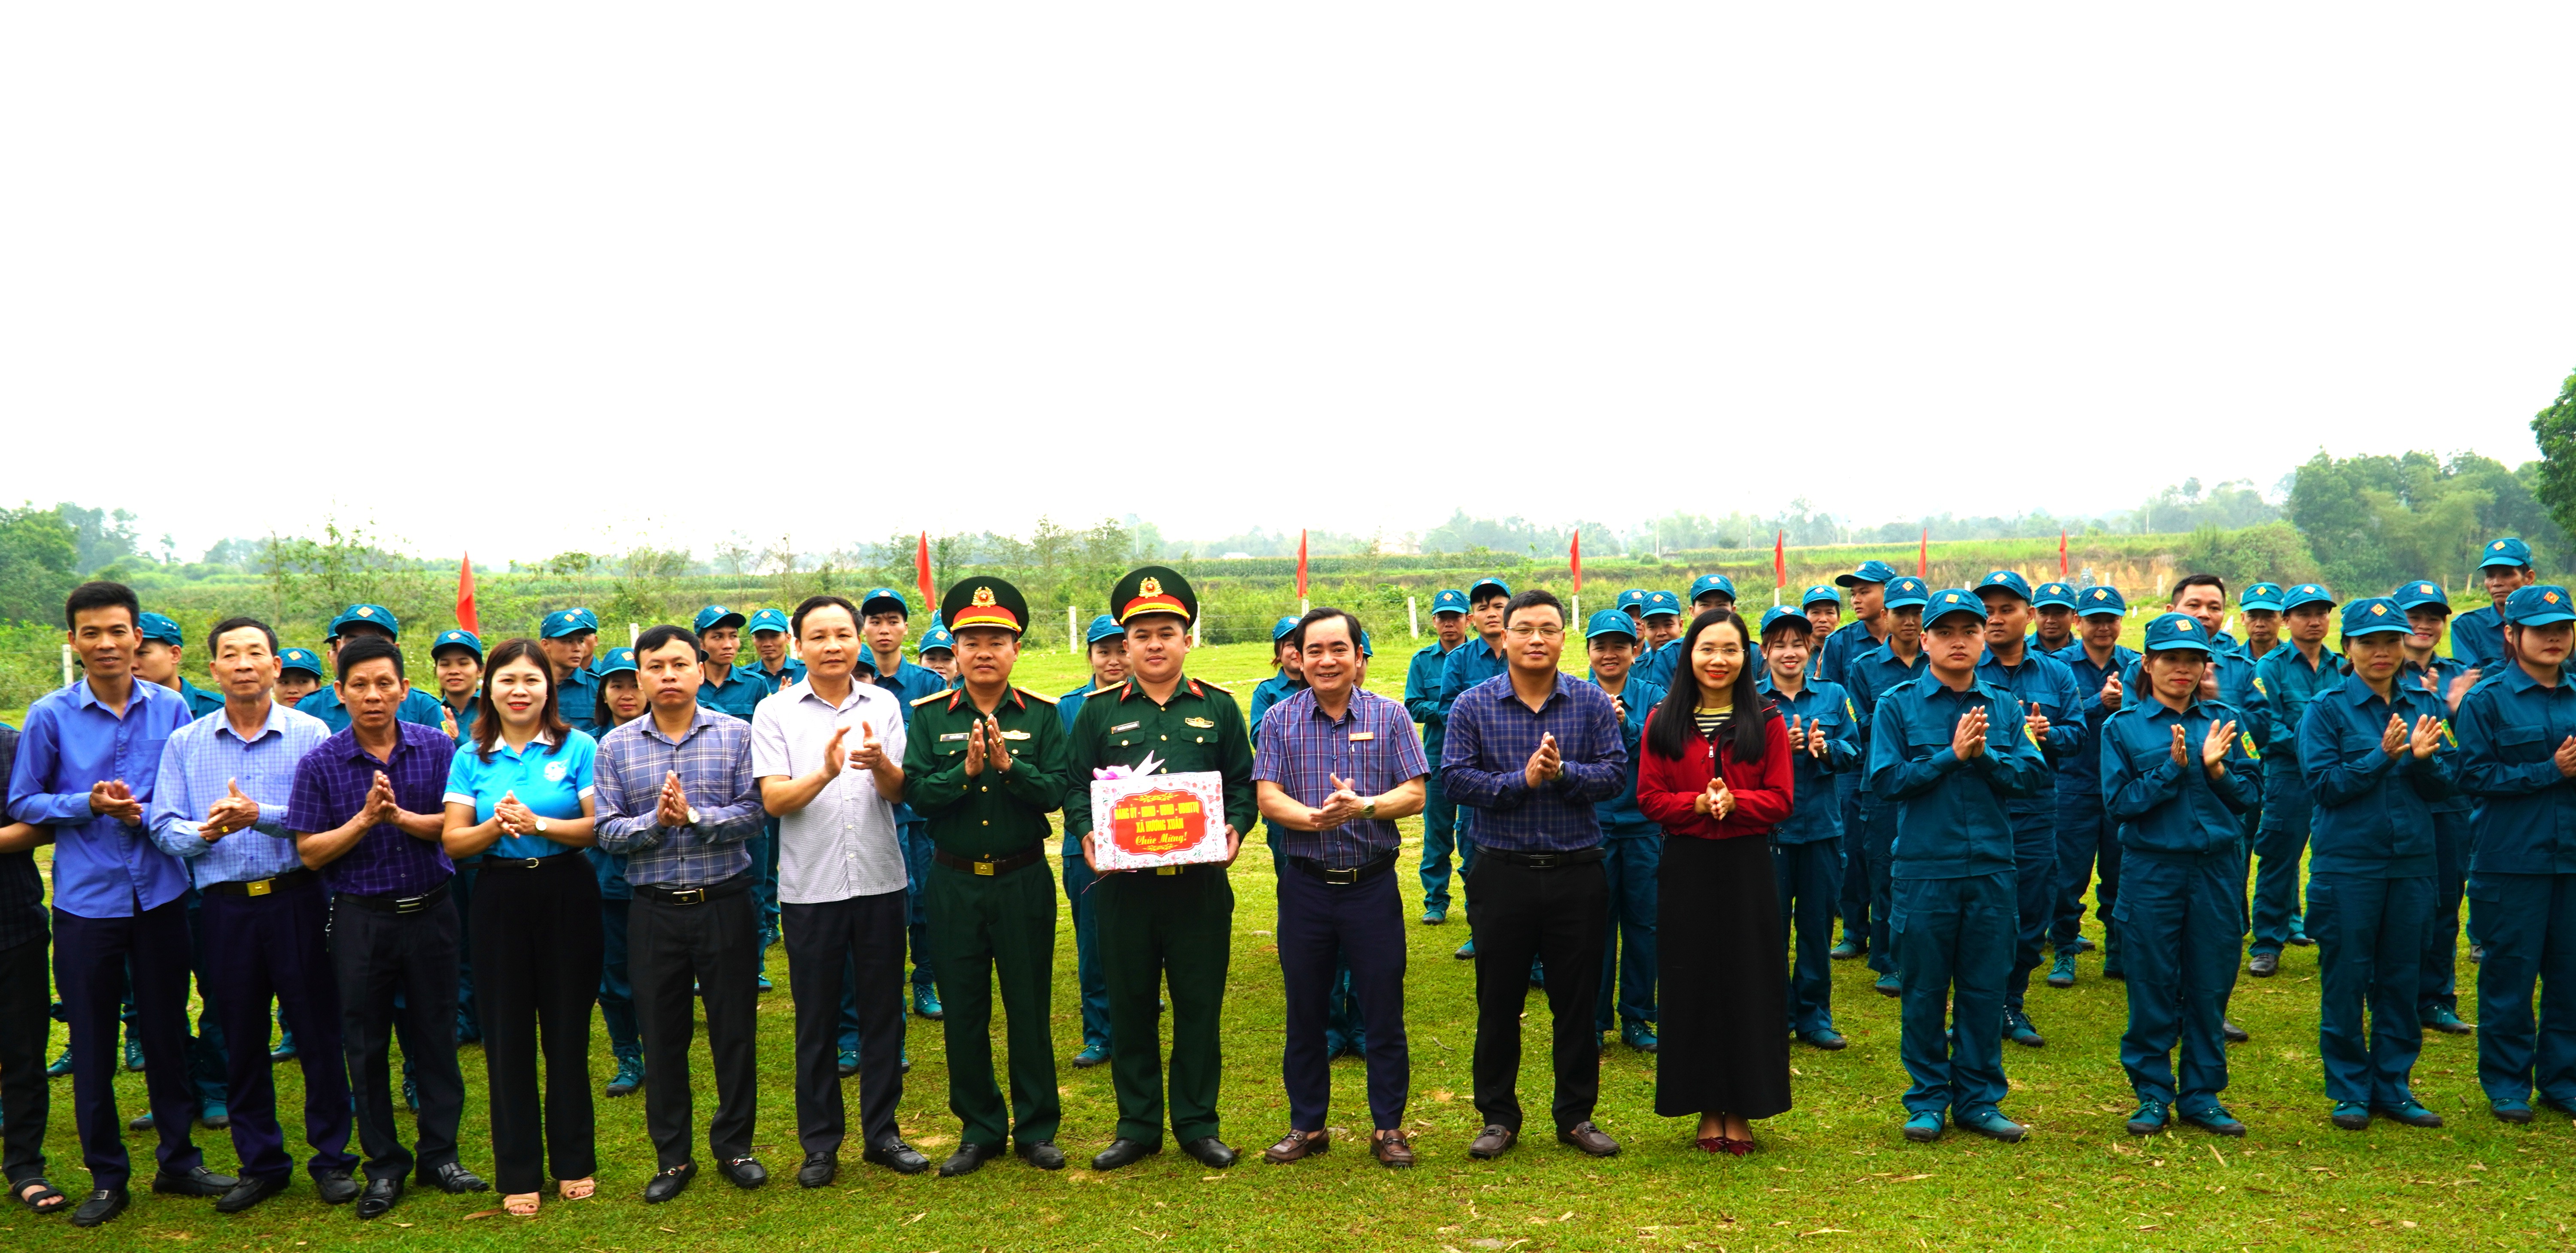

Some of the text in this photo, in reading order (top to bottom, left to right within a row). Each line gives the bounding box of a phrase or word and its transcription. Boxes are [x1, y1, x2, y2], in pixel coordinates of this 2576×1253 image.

[1136, 816, 1184, 833] XÃ HƯƠNG XUÂN
[1136, 831, 1188, 846] Chúc Mừng!
